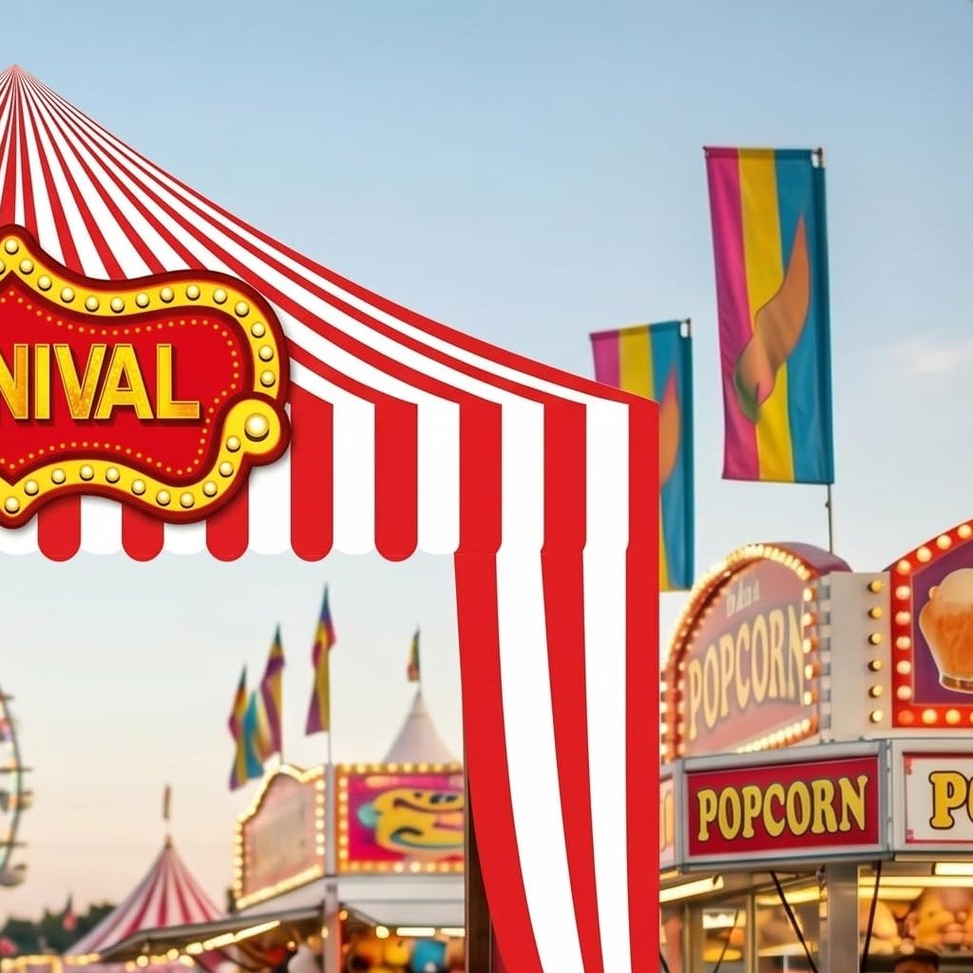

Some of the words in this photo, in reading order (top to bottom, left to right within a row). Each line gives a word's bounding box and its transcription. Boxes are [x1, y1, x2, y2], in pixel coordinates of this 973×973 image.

[688, 604, 804, 740] POPCORN
[696, 774, 869, 842] POPCORN
[928, 770, 973, 830] P
